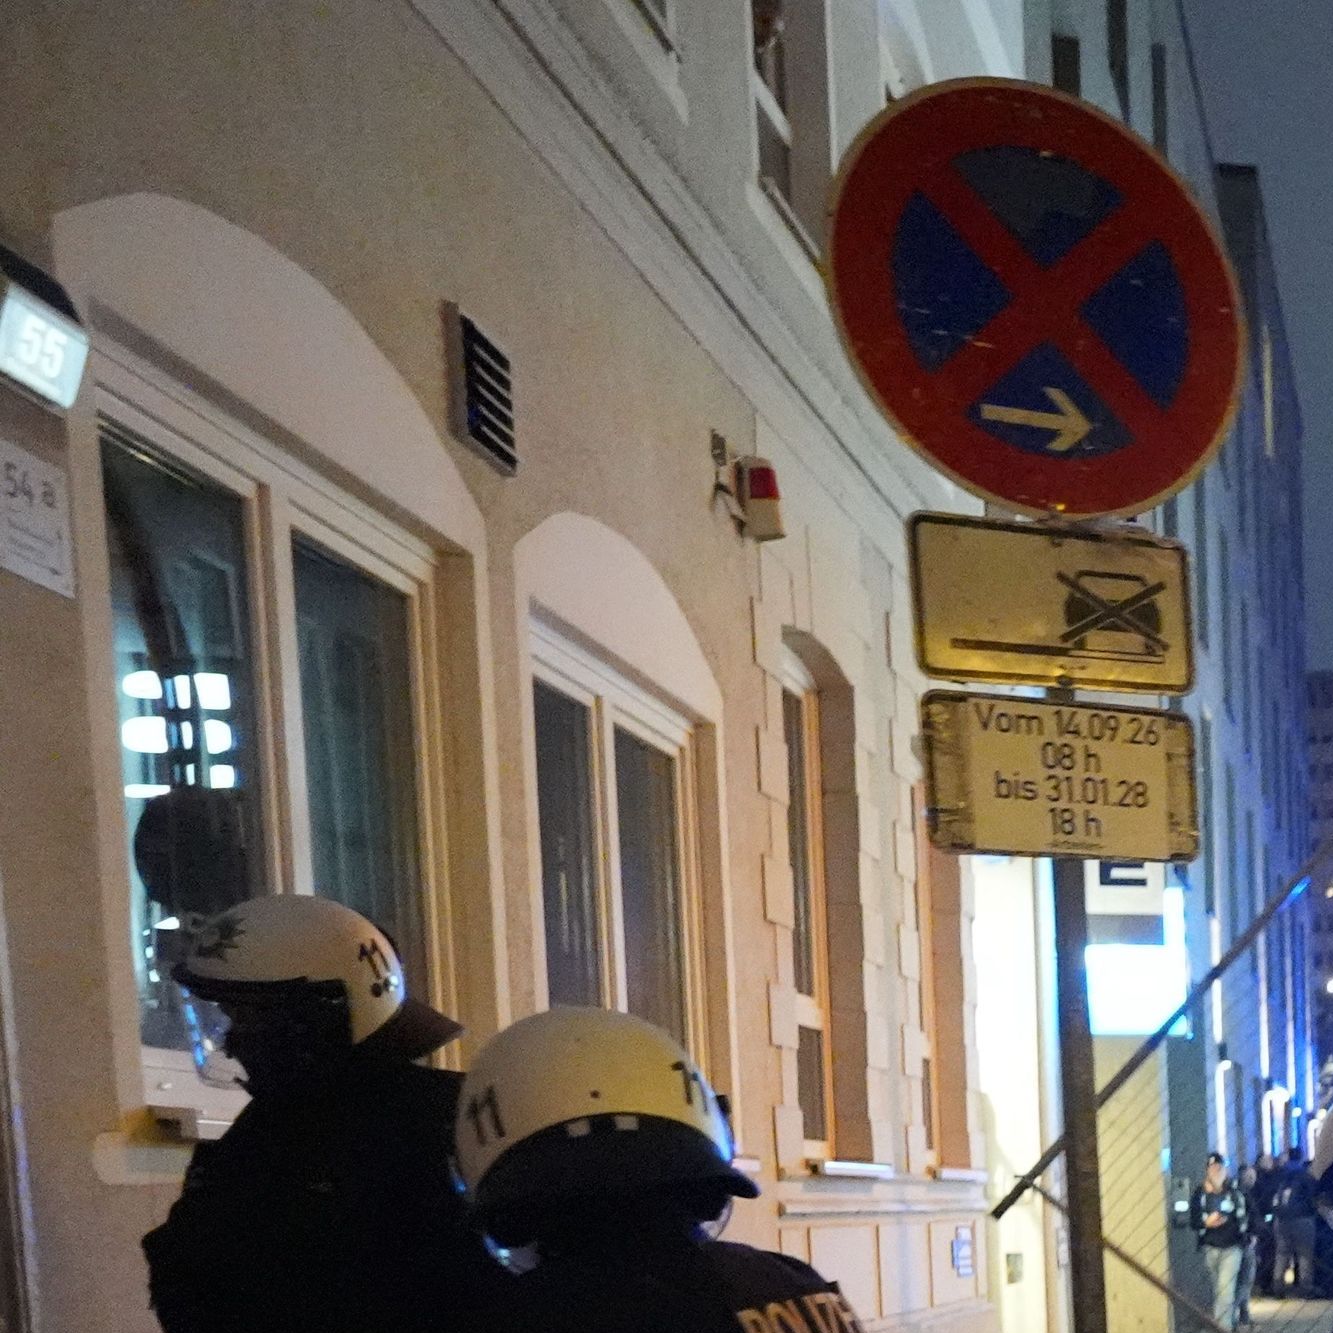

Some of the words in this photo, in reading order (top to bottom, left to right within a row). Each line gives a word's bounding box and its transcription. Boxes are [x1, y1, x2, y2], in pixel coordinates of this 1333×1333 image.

[21, 317, 67, 379] 55
[974, 702, 1045, 737] Vom
[1054, 710, 1160, 746] 14.09.26
[1041, 742, 1075, 770] 08
[1084, 744, 1101, 773] h
[994, 770, 1038, 801] bis
[1045, 774, 1149, 808] 31.01.28
[1048, 808, 1075, 835] 18
[1084, 810, 1101, 838] h
[467, 1086, 506, 1146] 11
